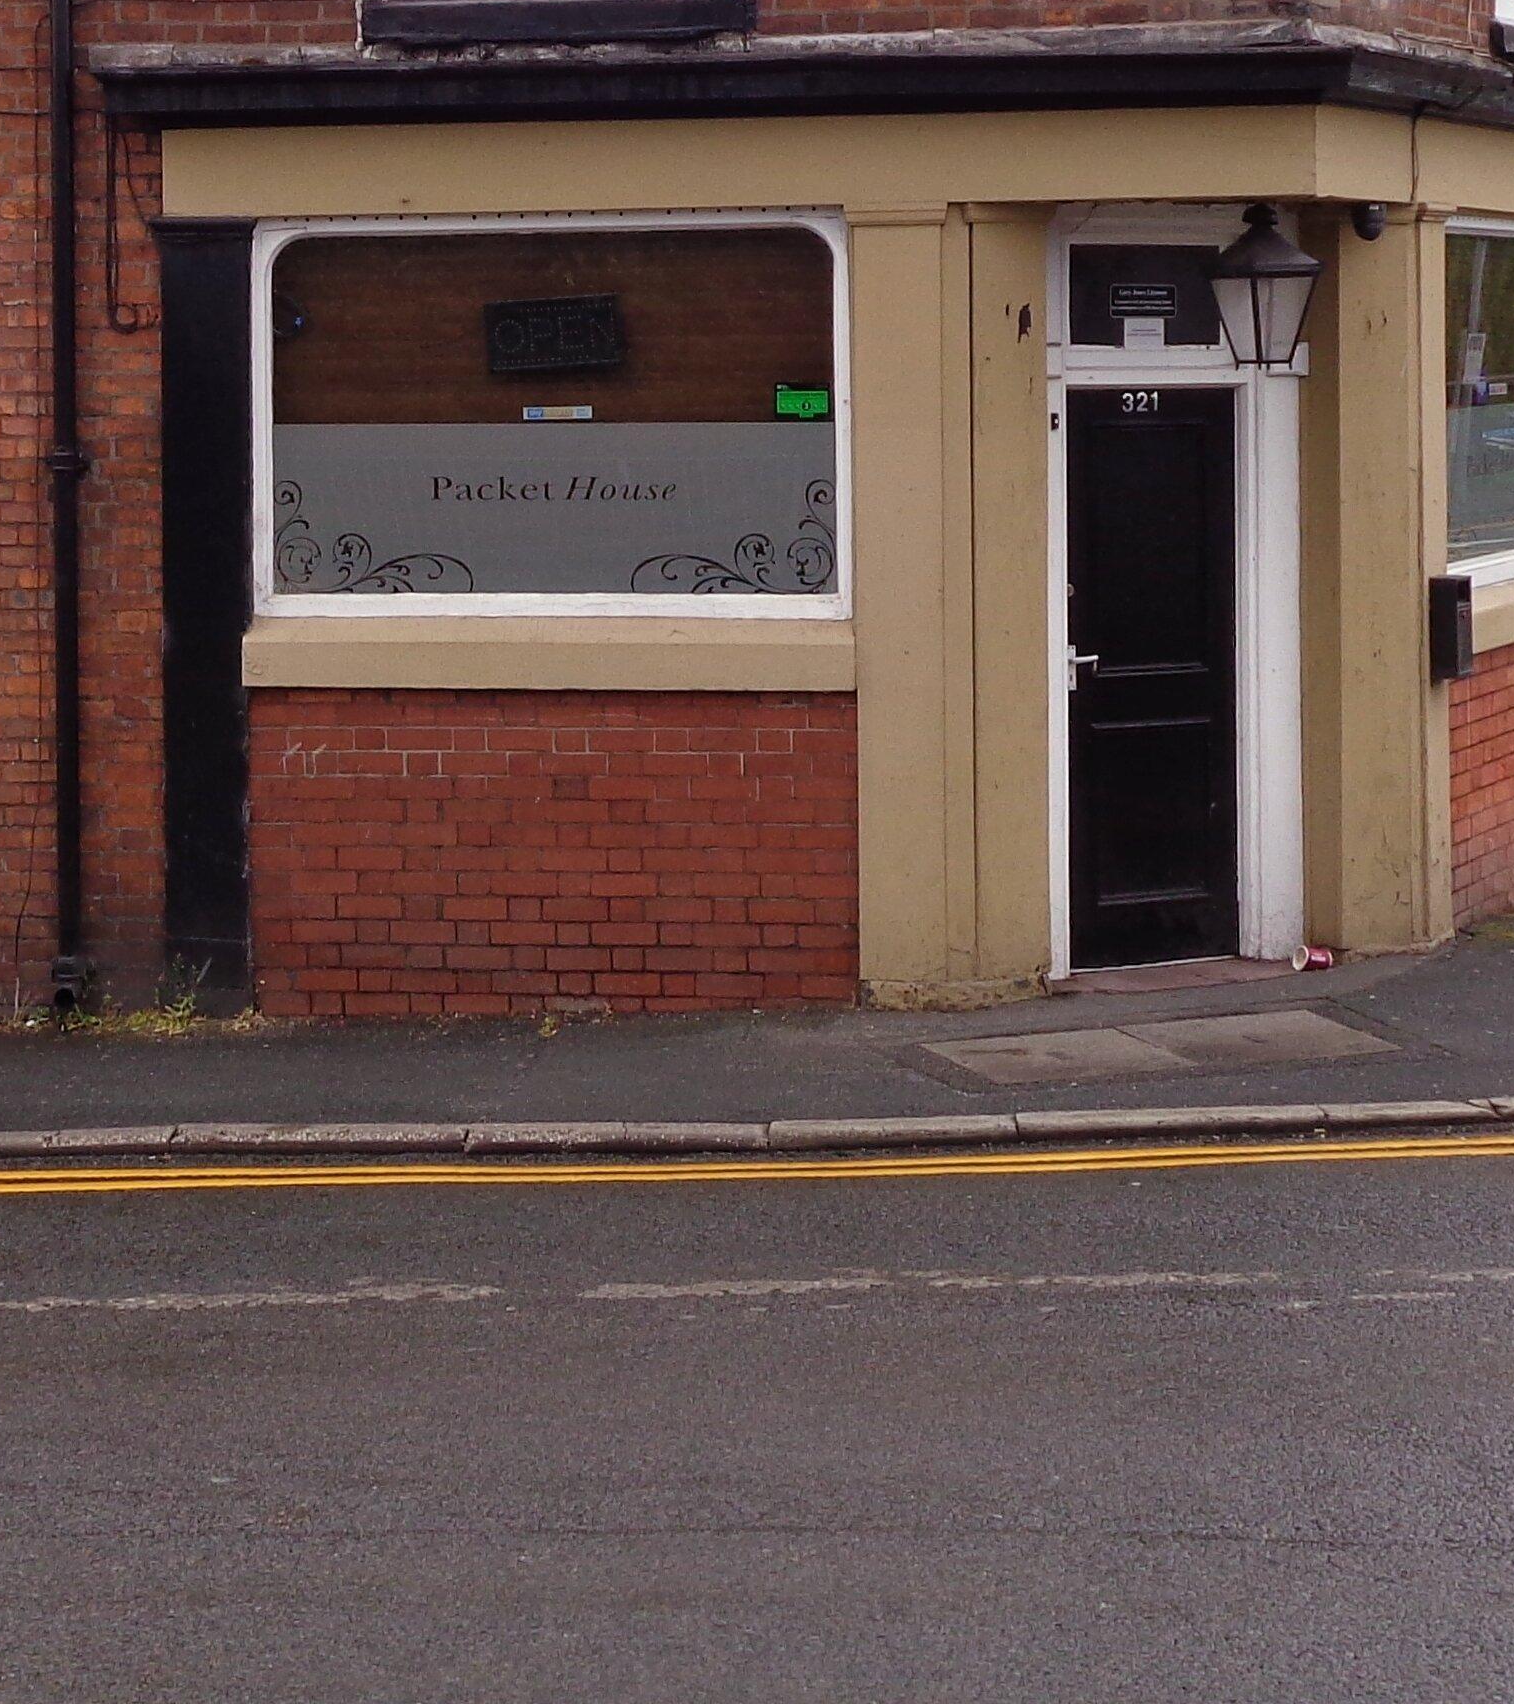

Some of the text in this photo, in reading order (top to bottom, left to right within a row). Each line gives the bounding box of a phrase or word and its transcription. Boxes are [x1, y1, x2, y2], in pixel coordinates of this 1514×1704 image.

[494, 314, 617, 354] OPEN
[1122, 391, 1160, 413] 321
[431, 474, 678, 502] Packet House
